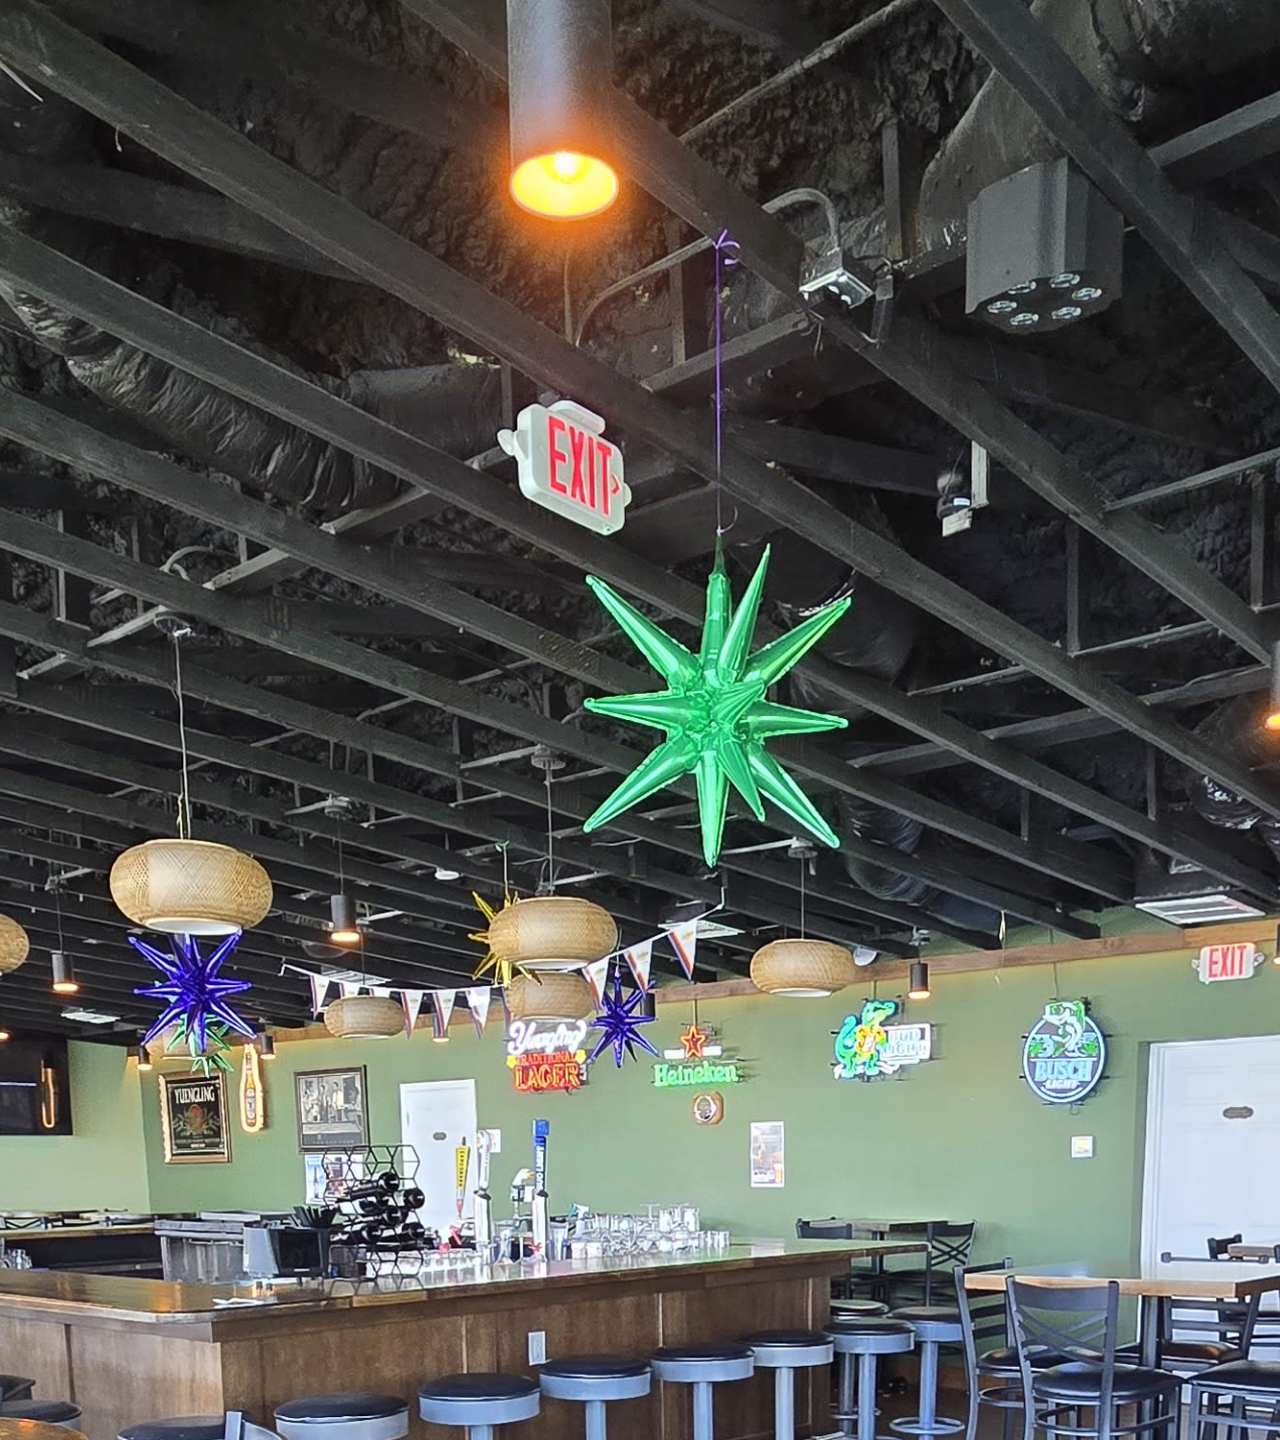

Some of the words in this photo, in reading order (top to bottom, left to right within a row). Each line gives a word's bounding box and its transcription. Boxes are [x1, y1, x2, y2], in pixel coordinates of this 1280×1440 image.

[547, 415, 612, 516] EXIT
[1208, 944, 1247, 978] EXIT
[888, 1028, 922, 1041] BUD
[517, 1050, 576, 1066] TRADITIONAL
[515, 1063, 580, 1089] LAGER
[654, 1060, 739, 1087] Heineken
[1034, 1060, 1093, 1082] BUSCH
[174, 1086, 216, 1104] YUENGLING
